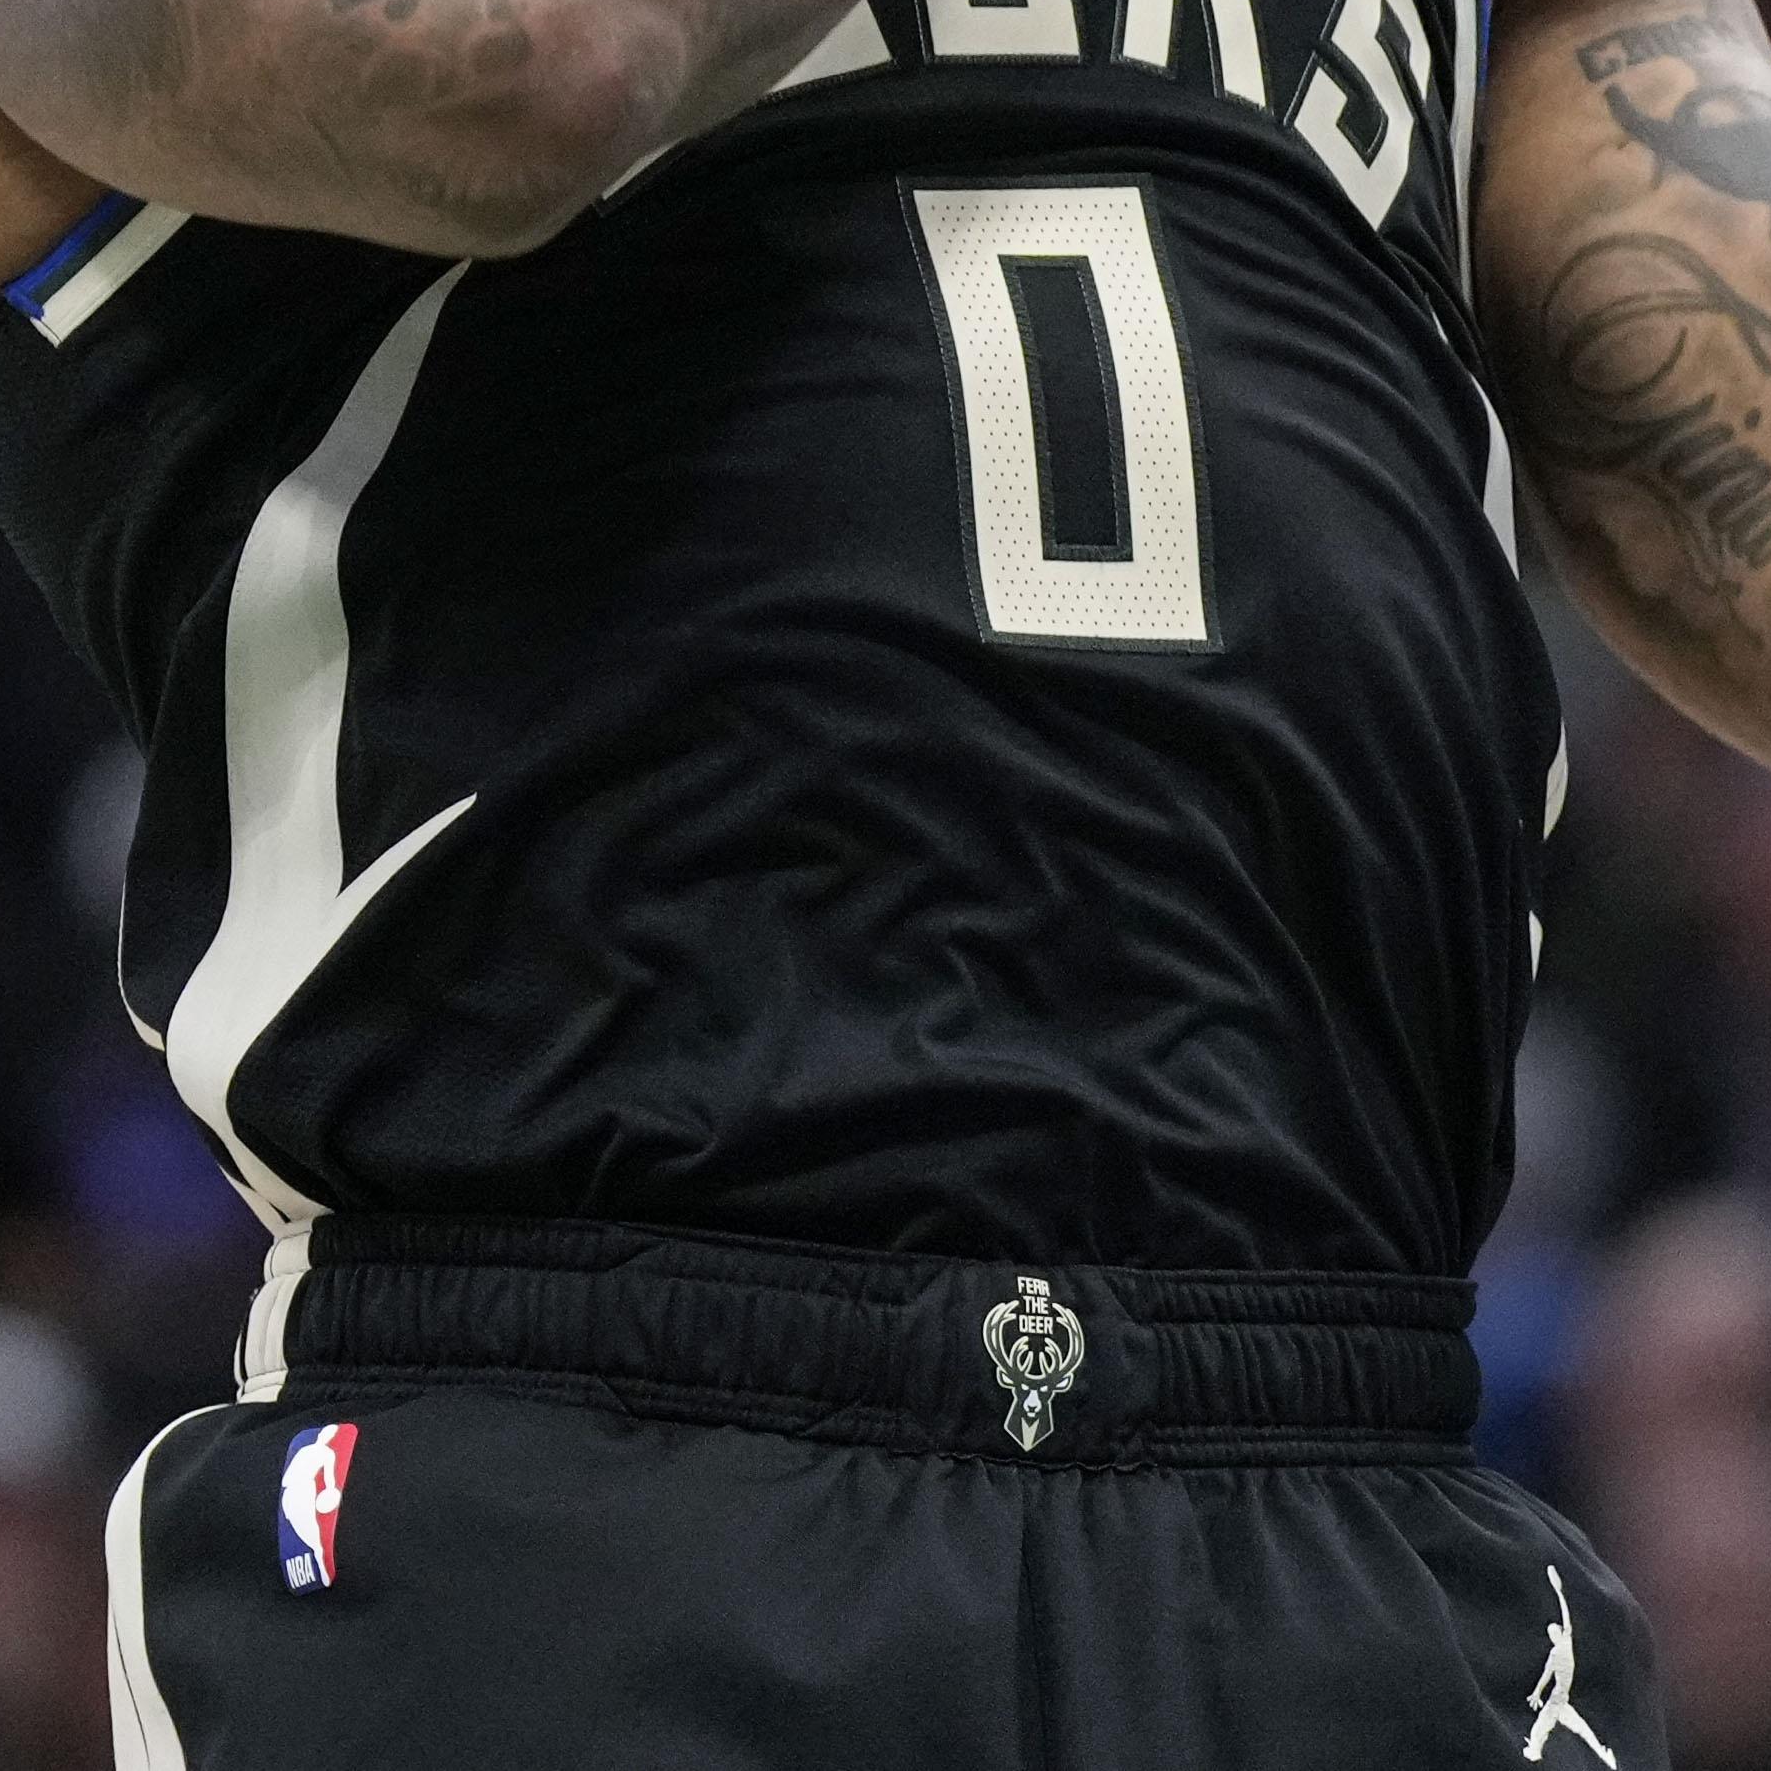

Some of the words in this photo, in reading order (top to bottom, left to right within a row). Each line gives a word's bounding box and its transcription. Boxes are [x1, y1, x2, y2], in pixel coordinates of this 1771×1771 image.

[911, 185, 1208, 642] 0
[1017, 1276, 1051, 1297] FEAR
[1022, 1295, 1049, 1315] THE
[1018, 1314, 1054, 1335] DEER
[285, 1552, 316, 1590] NBA
